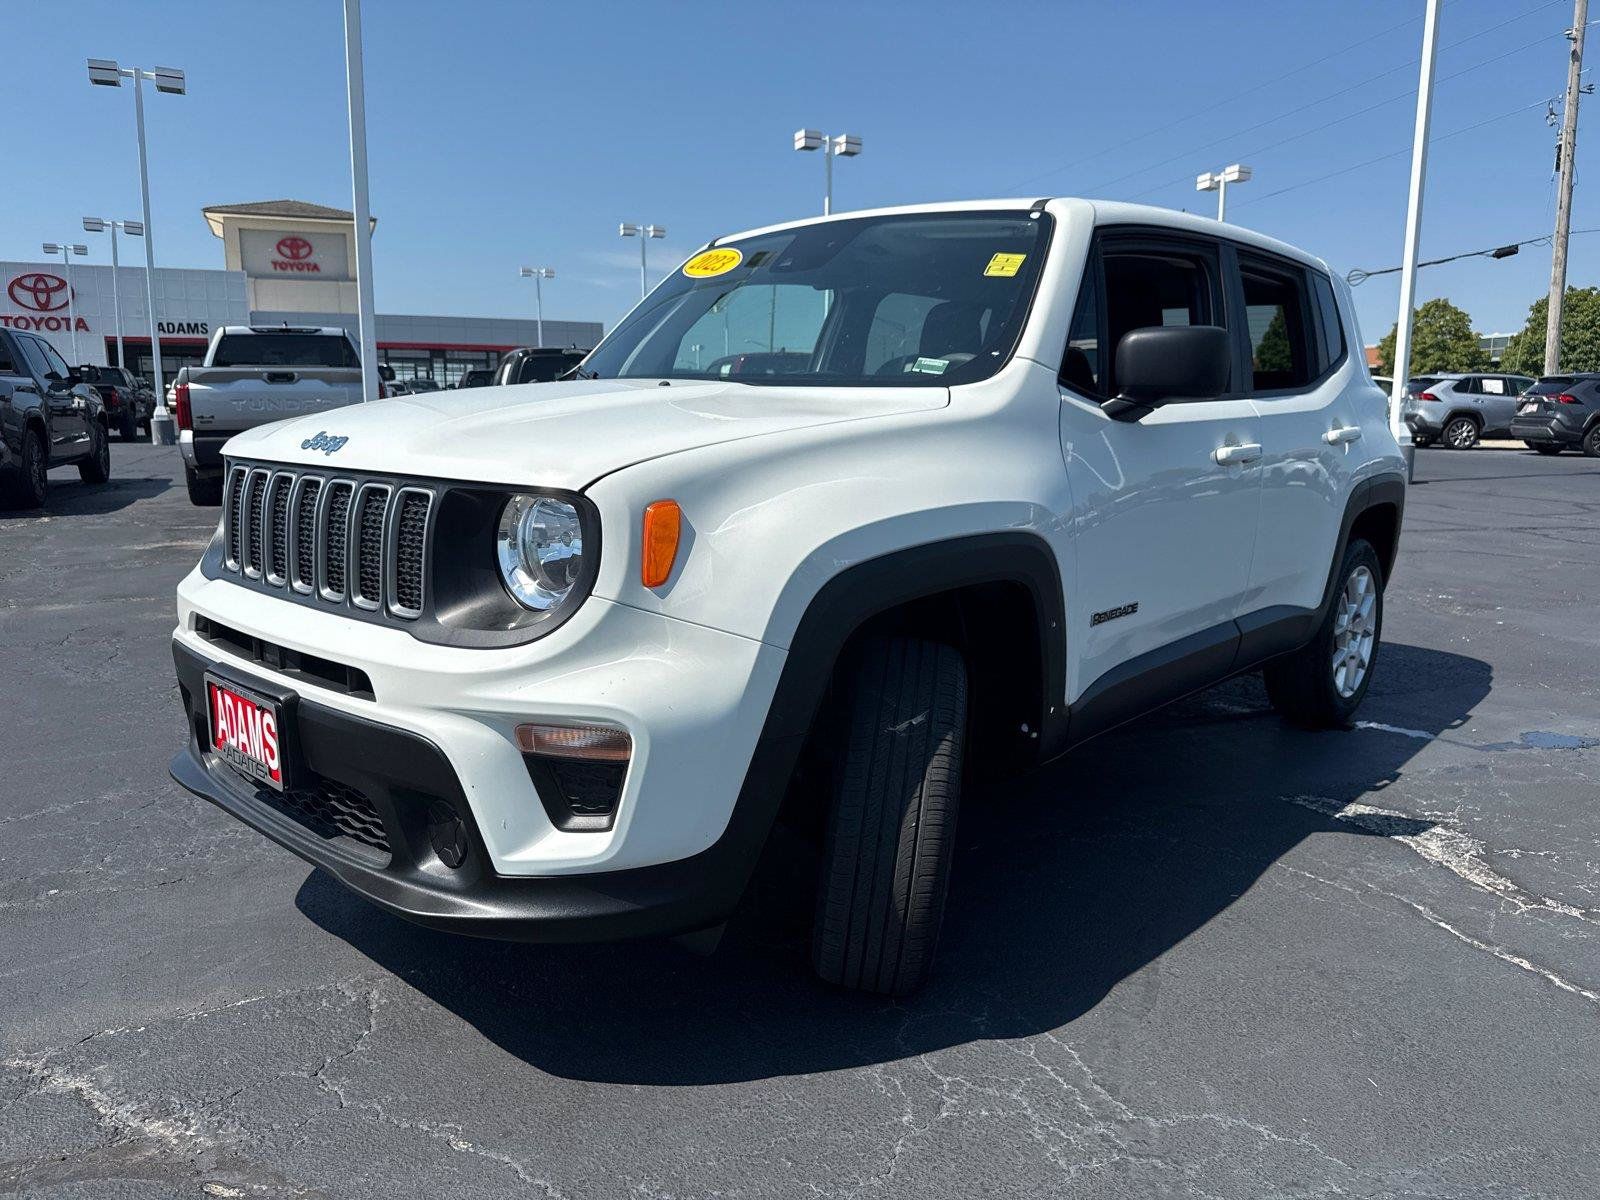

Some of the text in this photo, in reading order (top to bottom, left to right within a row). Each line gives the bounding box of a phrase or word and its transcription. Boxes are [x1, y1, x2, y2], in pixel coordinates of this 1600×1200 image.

[271, 261, 320, 272] TOYOTA
[688, 254, 735, 272] 2023
[0, 316, 90, 332] TOYOTA
[157, 322, 209, 335] ADAMS
[301, 431, 349, 456] Jeep
[1090, 602, 1139, 628] RENEGADE
[217, 689, 279, 771] ADAMS
